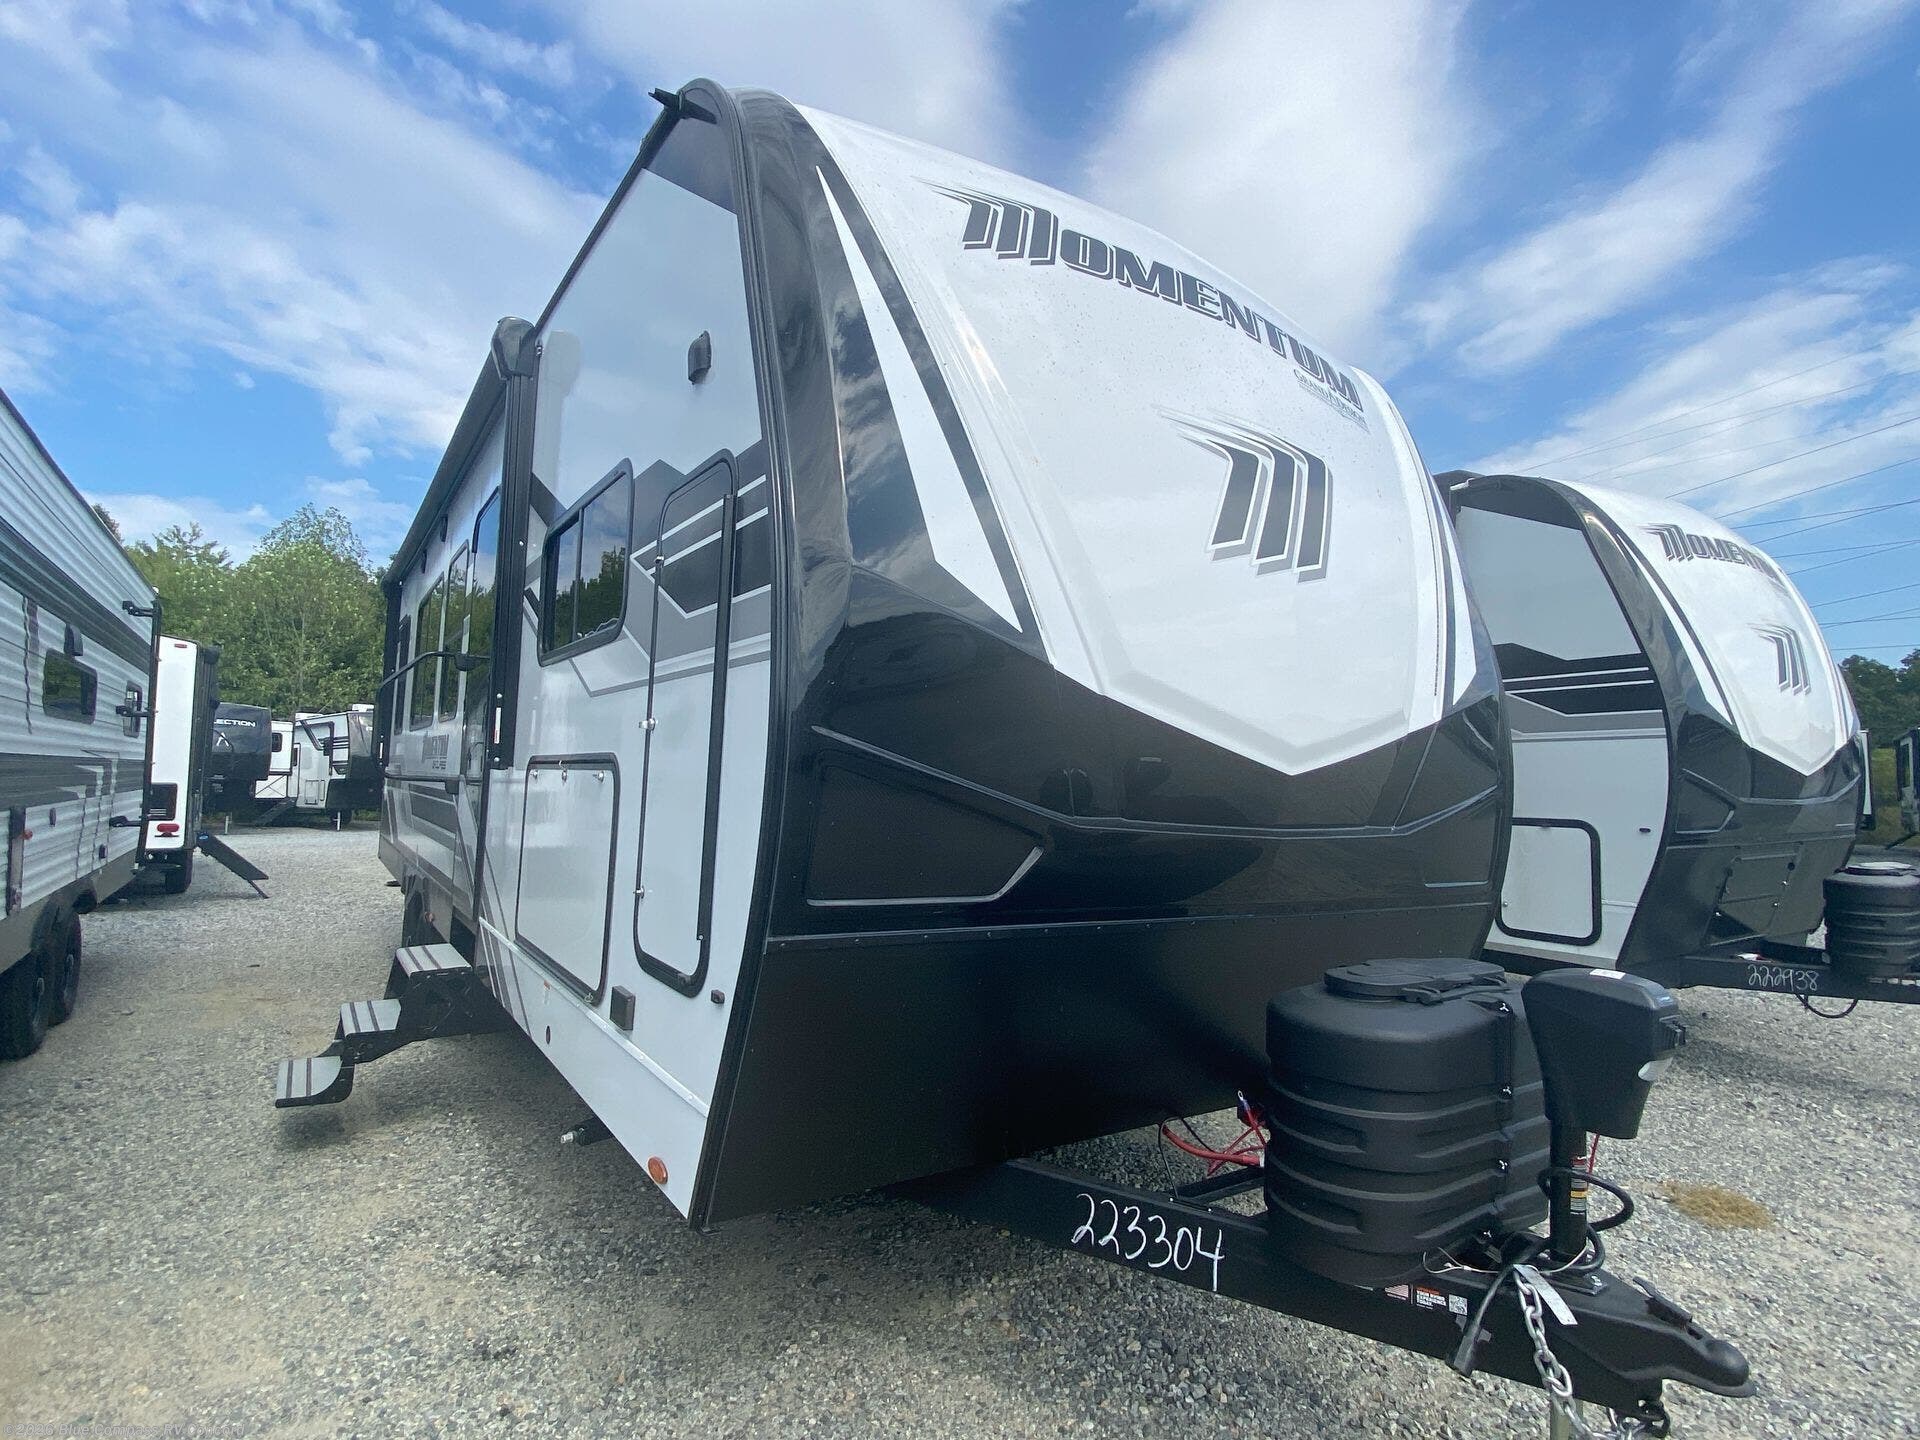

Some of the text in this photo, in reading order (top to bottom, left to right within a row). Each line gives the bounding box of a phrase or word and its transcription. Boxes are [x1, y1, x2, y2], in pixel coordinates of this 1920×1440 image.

[945, 186, 1363, 412] MOMENTUM
[1747, 964, 1819, 992] 222938
[1071, 1193, 1225, 1292] 223304
